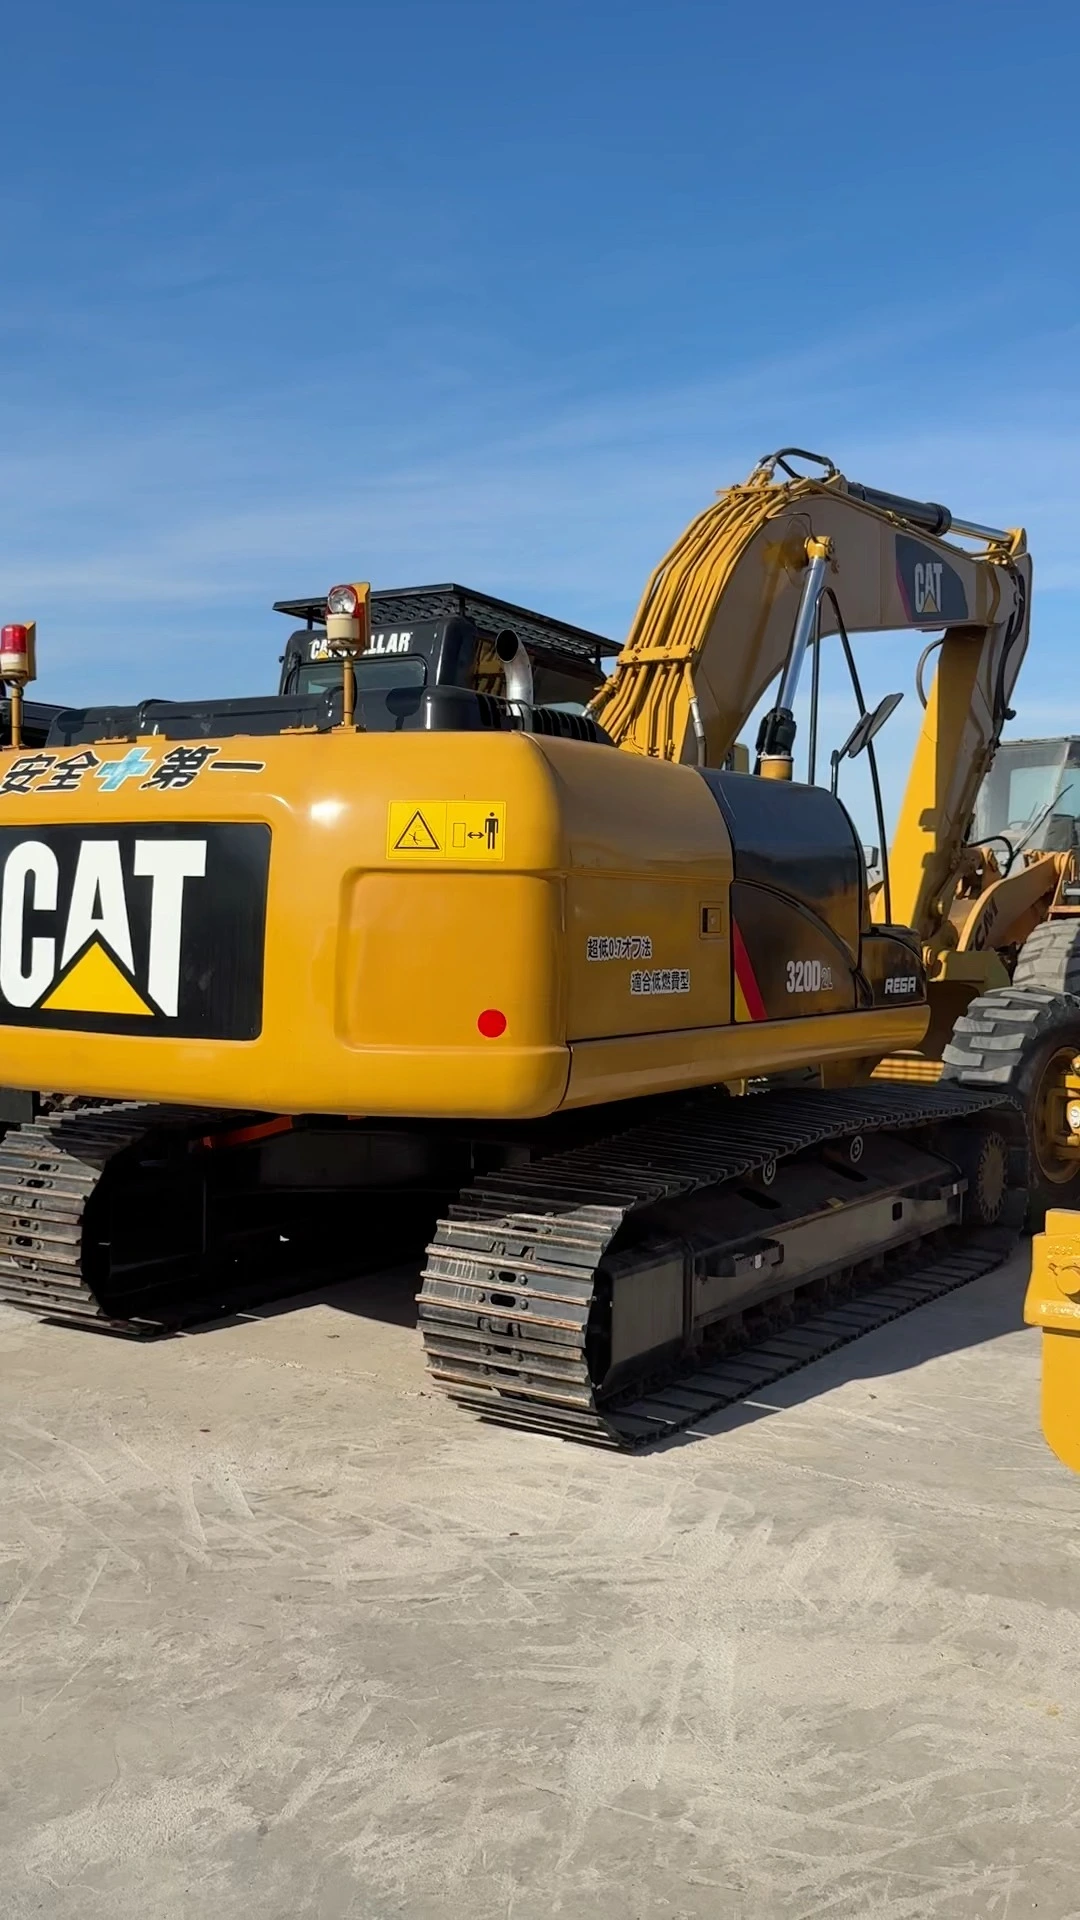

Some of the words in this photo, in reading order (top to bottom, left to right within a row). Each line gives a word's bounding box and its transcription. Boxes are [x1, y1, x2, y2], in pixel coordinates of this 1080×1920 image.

[915, 563, 942, 613] CAT
[310, 632, 411, 659] CALLAR
[0, 840, 207, 1017] CAT
[884, 976, 917, 994] REGA
